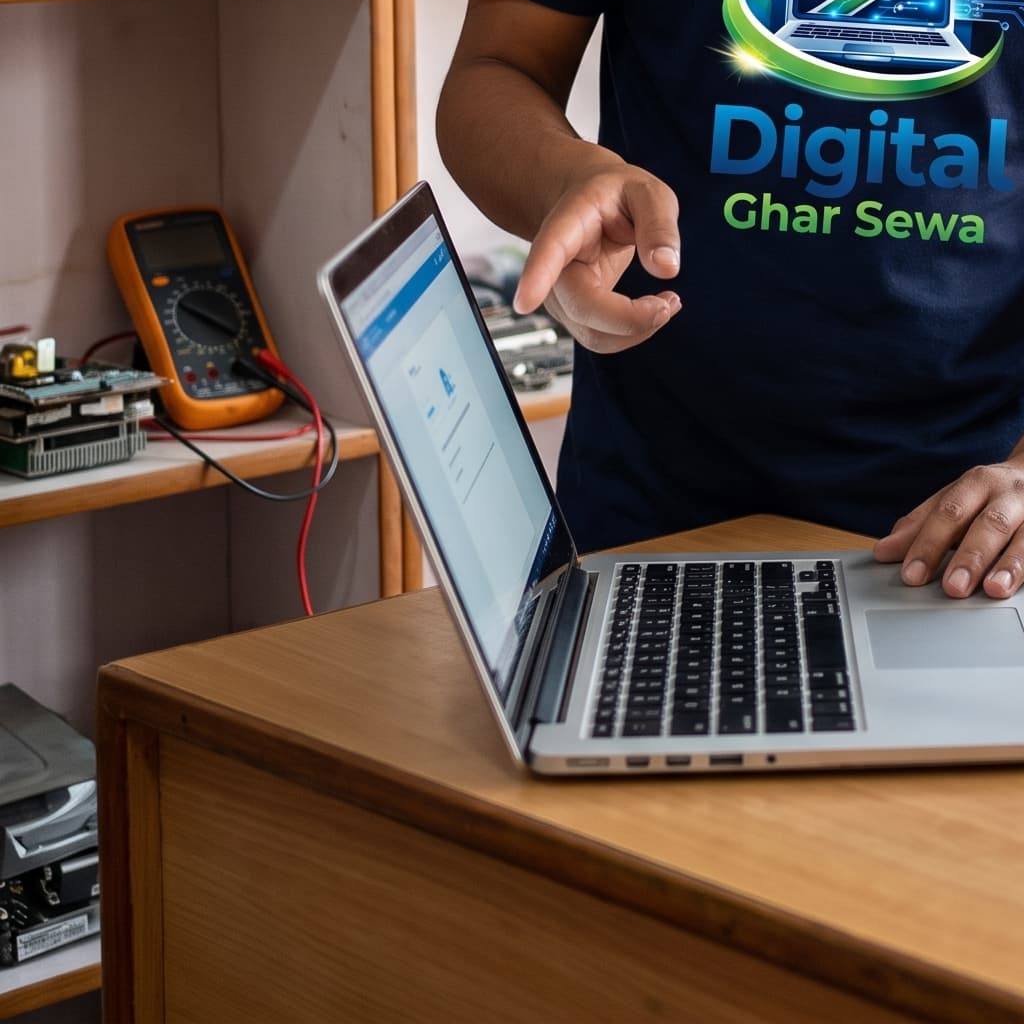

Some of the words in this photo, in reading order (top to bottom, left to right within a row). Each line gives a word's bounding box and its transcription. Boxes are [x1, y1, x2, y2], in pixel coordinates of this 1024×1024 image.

[709, 103, 1014, 198] Digital
[723, 192, 841, 235] Ghar
[855, 200, 985, 244] Sewa
